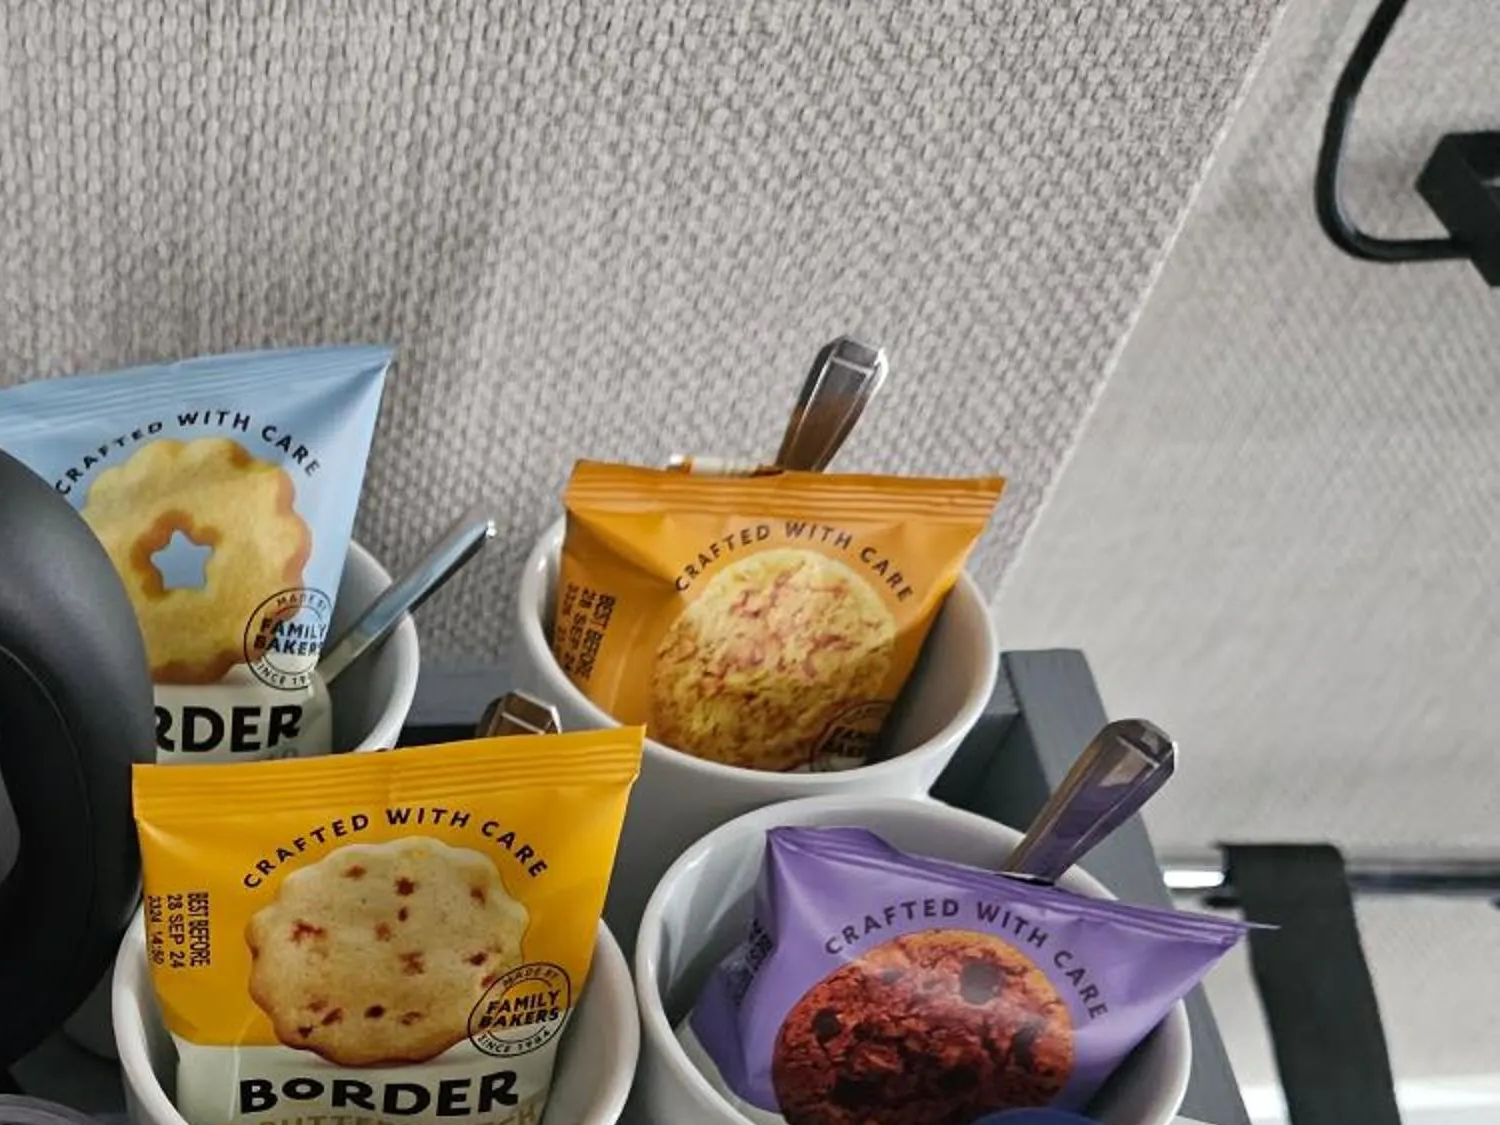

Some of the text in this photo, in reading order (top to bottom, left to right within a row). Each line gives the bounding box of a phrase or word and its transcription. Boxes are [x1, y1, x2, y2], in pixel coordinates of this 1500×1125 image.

[55, 411, 321, 495] CRAFTED WITH CARE
[675, 522, 914, 602] CRAFTED WITH CARE
[260, 618, 327, 641] FAMILY
[154, 704, 303, 753] RDER
[243, 808, 547, 889] CRAFTED WITH CARE
[167, 894, 185, 969] 28 SEP 24
[187, 892, 211, 967] BEST BEFORE
[825, 899, 959, 955] CRAFTED
[977, 901, 1048, 948] WITH
[1053, 950, 1109, 1020] CARE
[478, 1007, 560, 1028] BAKERS
[487, 990, 560, 1014] FAMILY
[240, 1070, 519, 1117] BORDER
